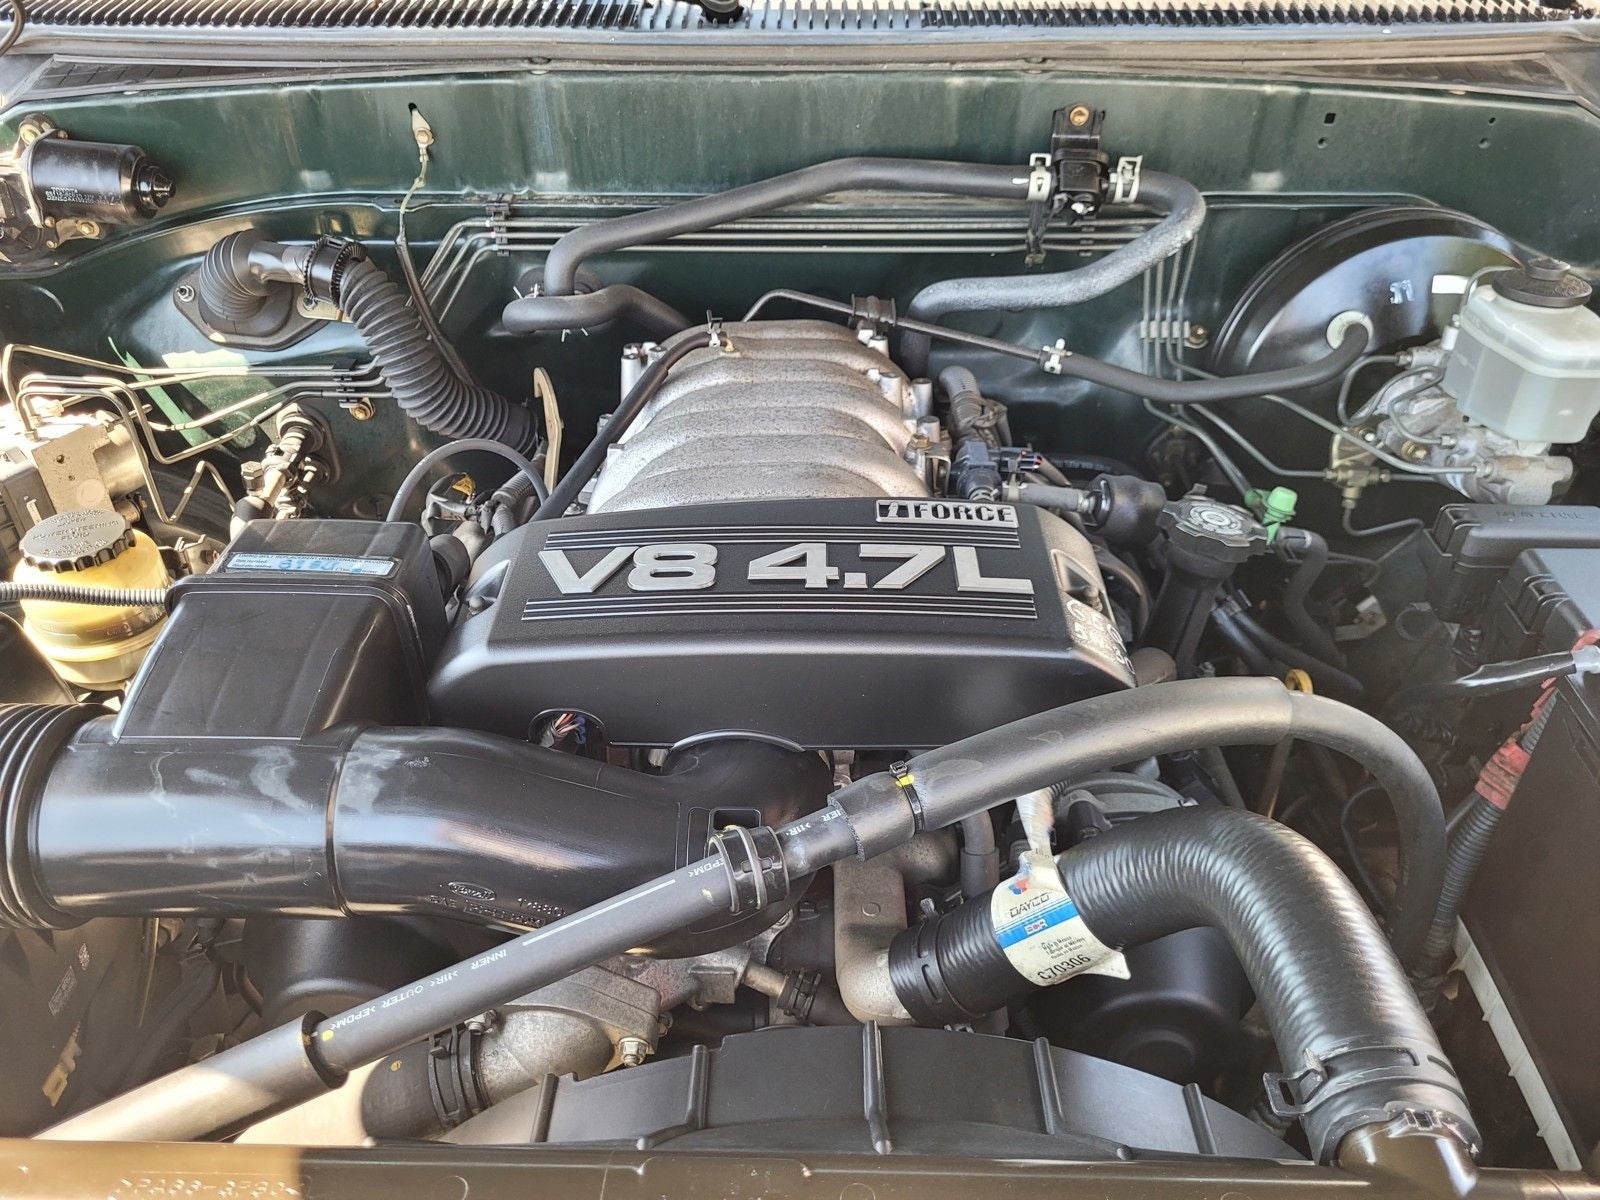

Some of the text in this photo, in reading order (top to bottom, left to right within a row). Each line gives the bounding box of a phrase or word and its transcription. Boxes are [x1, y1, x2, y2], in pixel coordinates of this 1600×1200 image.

[538, 542, 1035, 595] V8 4.7L
[1010, 892, 1050, 919] DAYCO
[471, 949, 507, 970] INNER
[1037, 953, 1091, 981] C70306
[382, 985, 424, 1009] OUTER
